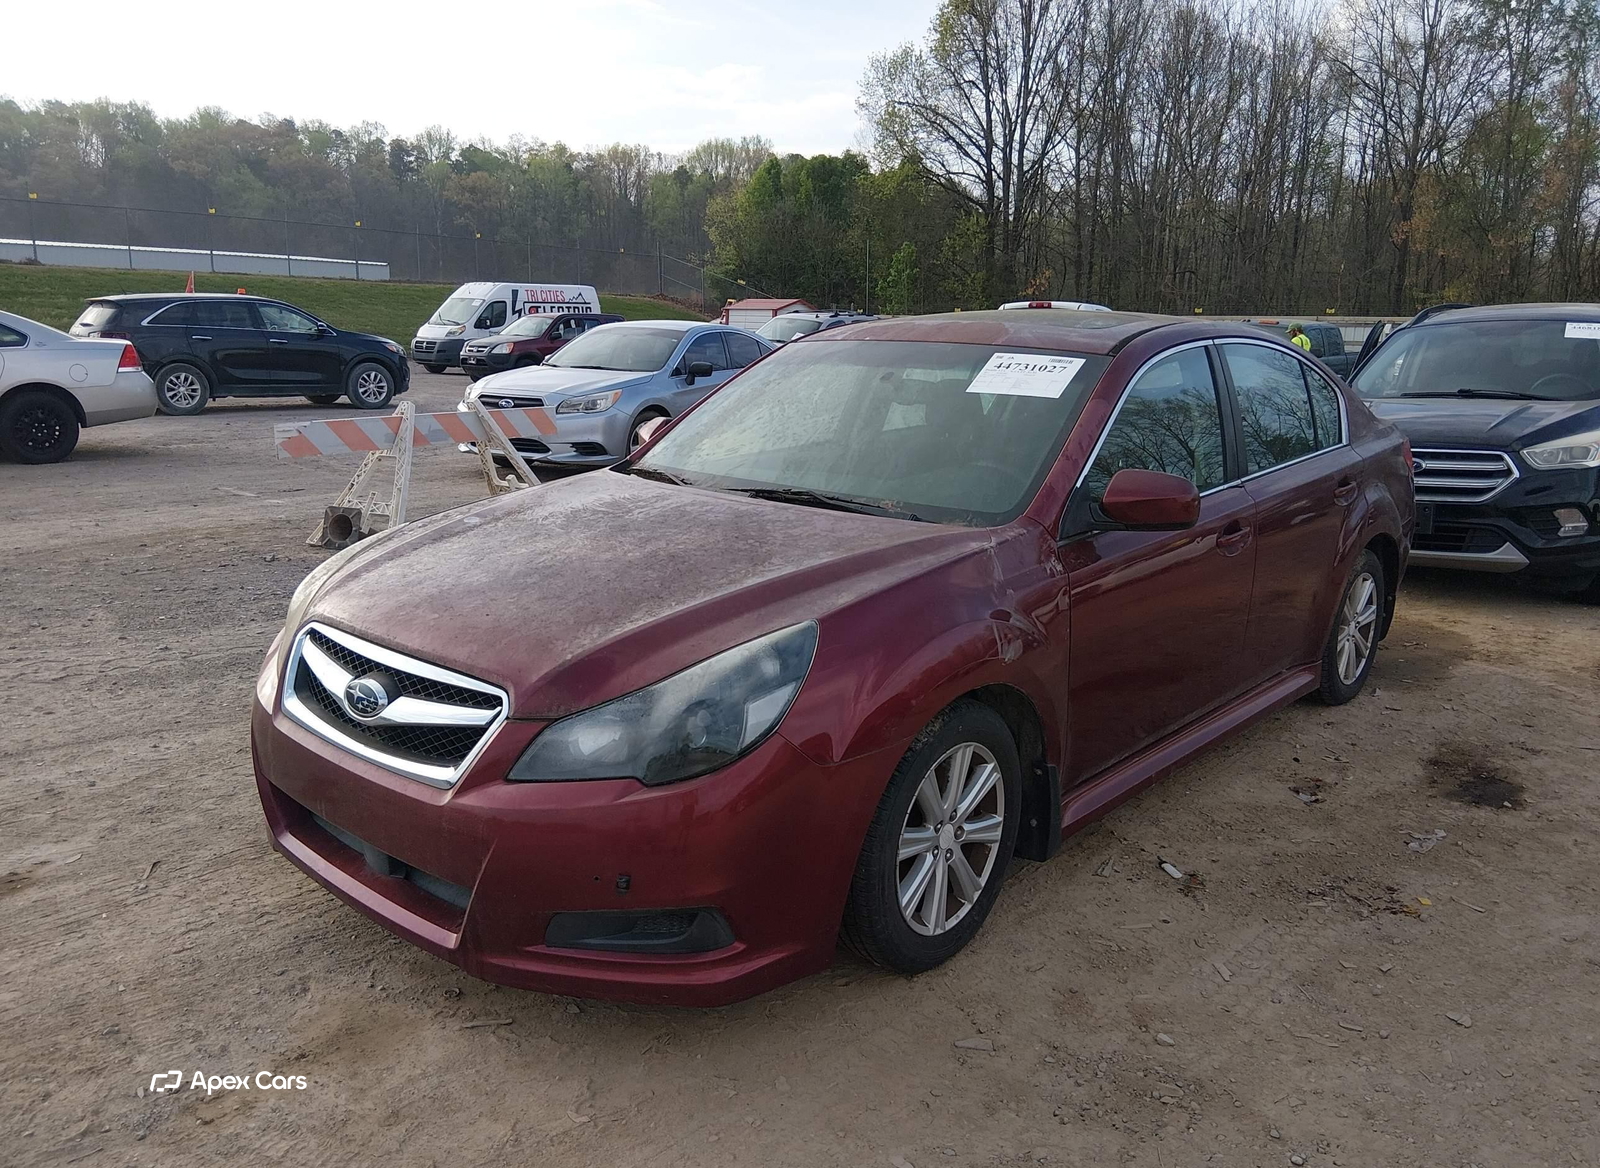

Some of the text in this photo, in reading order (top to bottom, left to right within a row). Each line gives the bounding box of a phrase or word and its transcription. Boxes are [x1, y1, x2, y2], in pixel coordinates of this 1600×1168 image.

[525, 289, 566, 302] TRI CITIES
[993, 361, 1068, 374] 44731027
